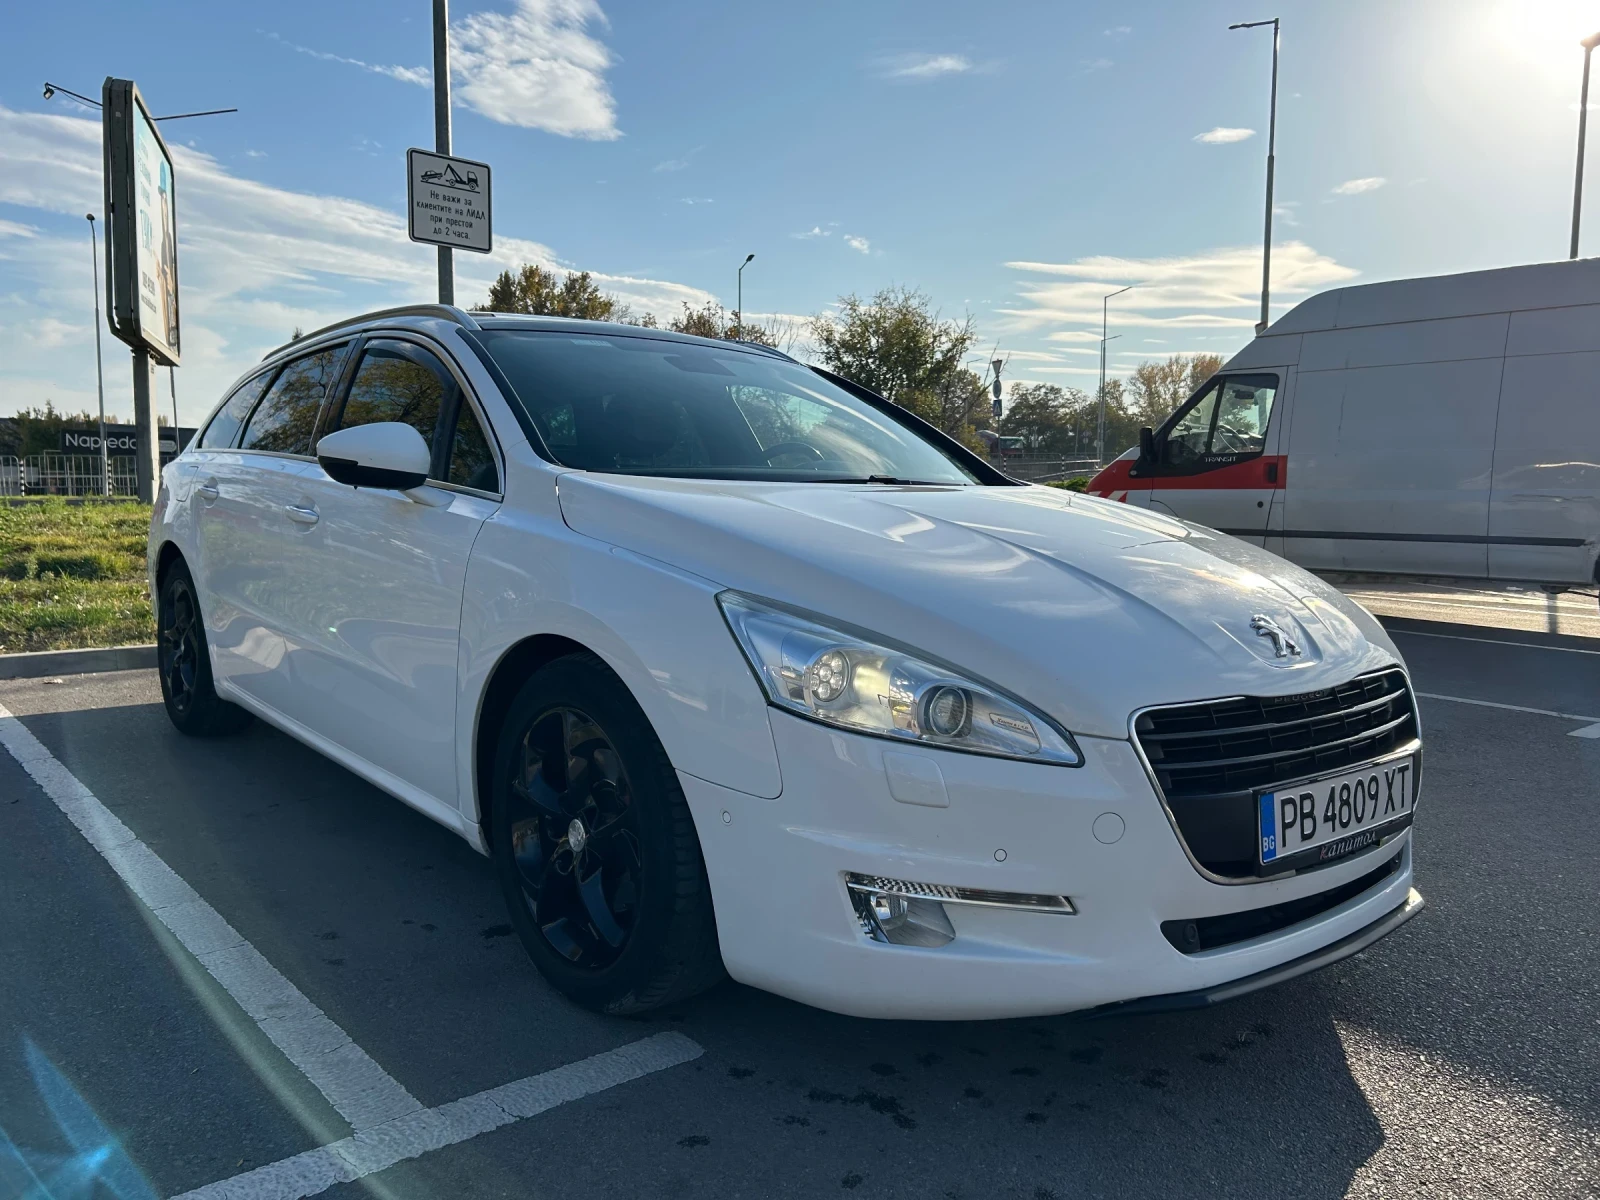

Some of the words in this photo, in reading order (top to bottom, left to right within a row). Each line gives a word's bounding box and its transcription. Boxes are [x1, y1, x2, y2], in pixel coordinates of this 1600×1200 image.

[430, 190, 440, 200] Не
[443, 194, 460, 204] важи
[464, 198, 472, 206] за
[416, 200, 451, 213] клиентите
[455, 208, 463, 216] на
[466, 208, 485, 220] ЛИДЛ
[430, 214, 442, 224] при
[446, 217, 473, 229] престой
[433, 227, 442, 235] до
[445, 226, 450, 236] 2
[452, 230, 470, 239] часа.
[1280, 790, 1317, 848] PB
[1323, 773, 1380, 833] 4809
[1383, 763, 1410, 815] XT
[1262, 835, 1275, 852] BG
